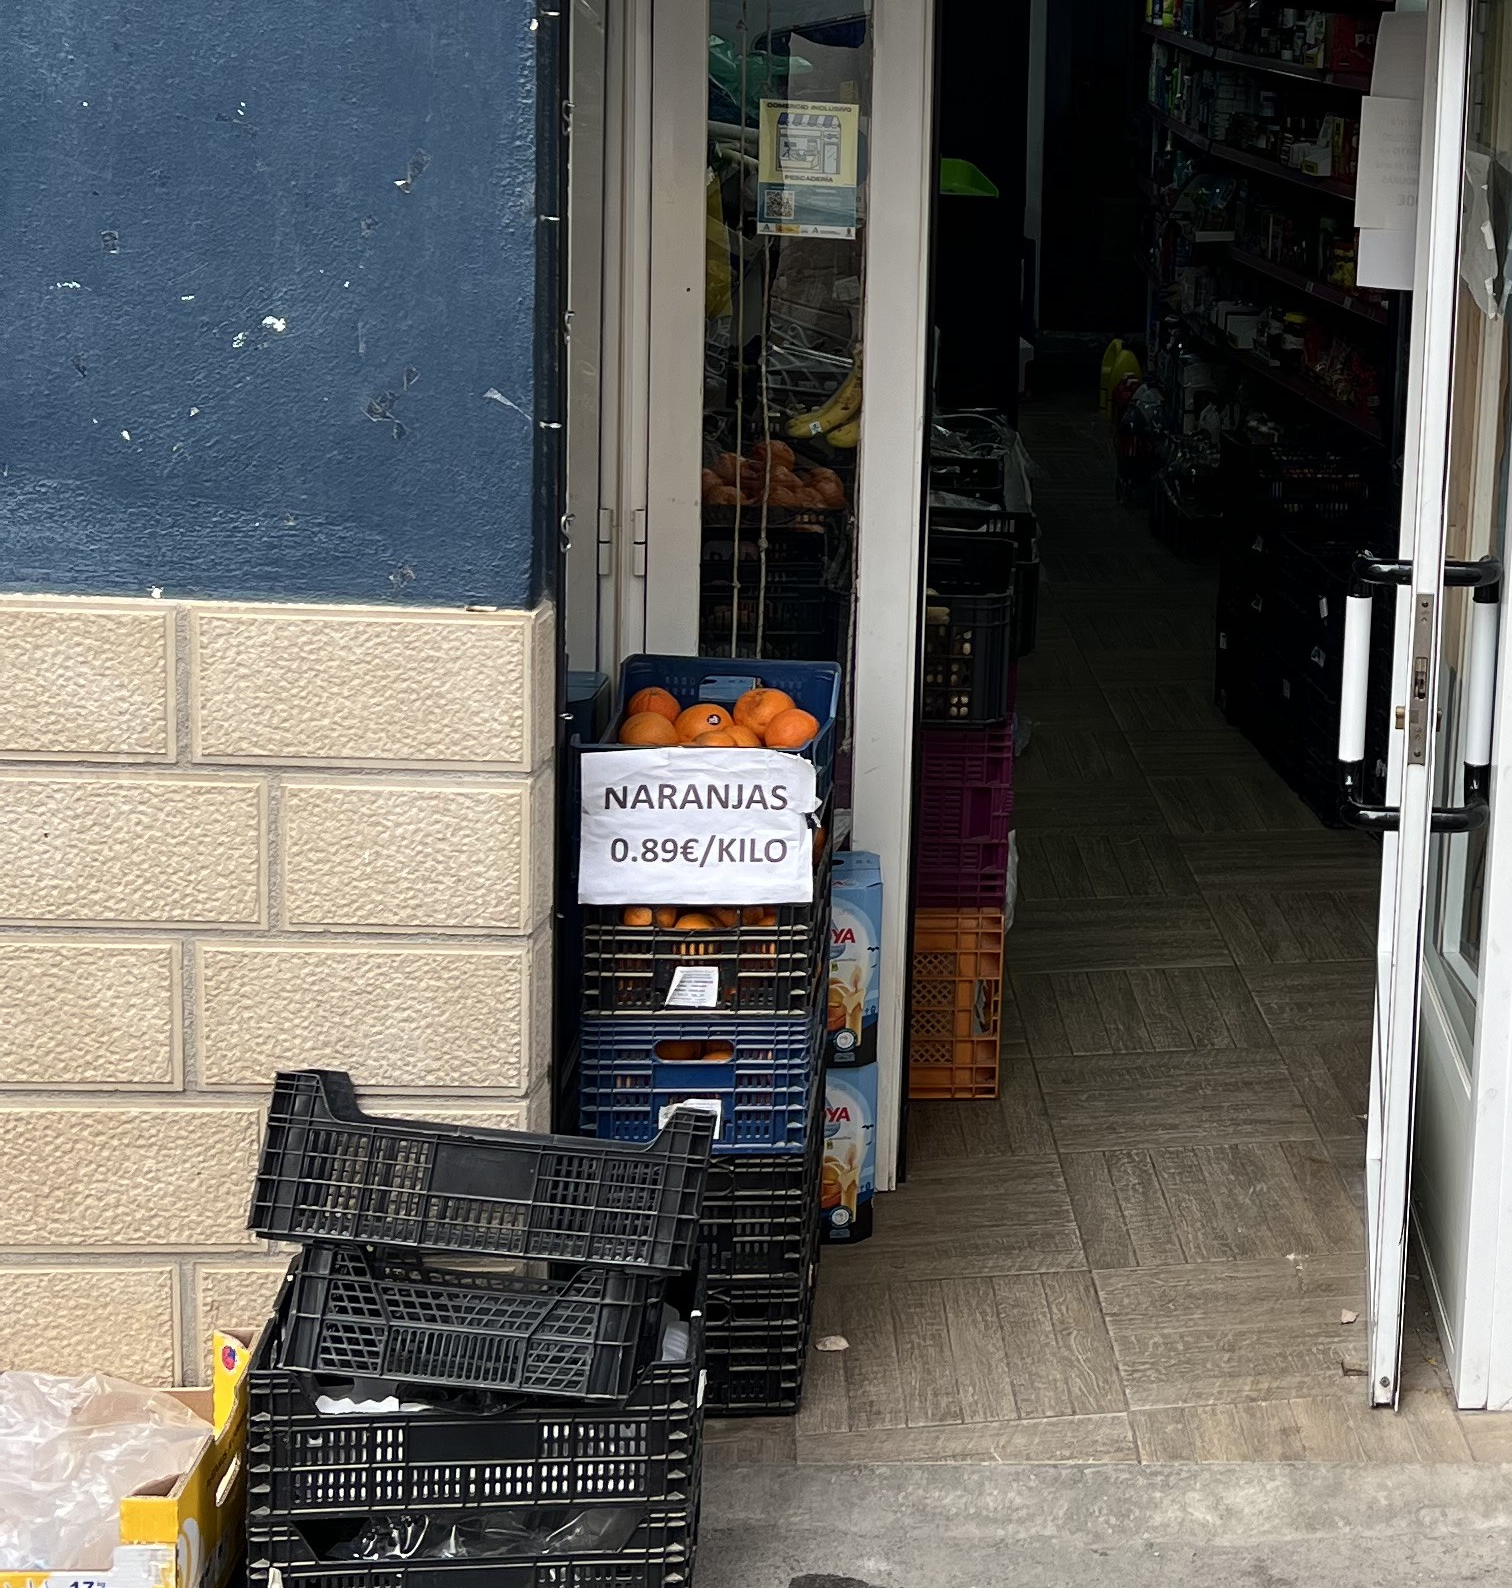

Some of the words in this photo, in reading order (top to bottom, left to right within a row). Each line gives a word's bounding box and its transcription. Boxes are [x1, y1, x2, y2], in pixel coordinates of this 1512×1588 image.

[604, 783, 788, 811] NARANJAS
[610, 834, 788, 868] 0.89€/KILO
[831, 927, 856, 944] YA
[826, 1106, 851, 1123] YA
